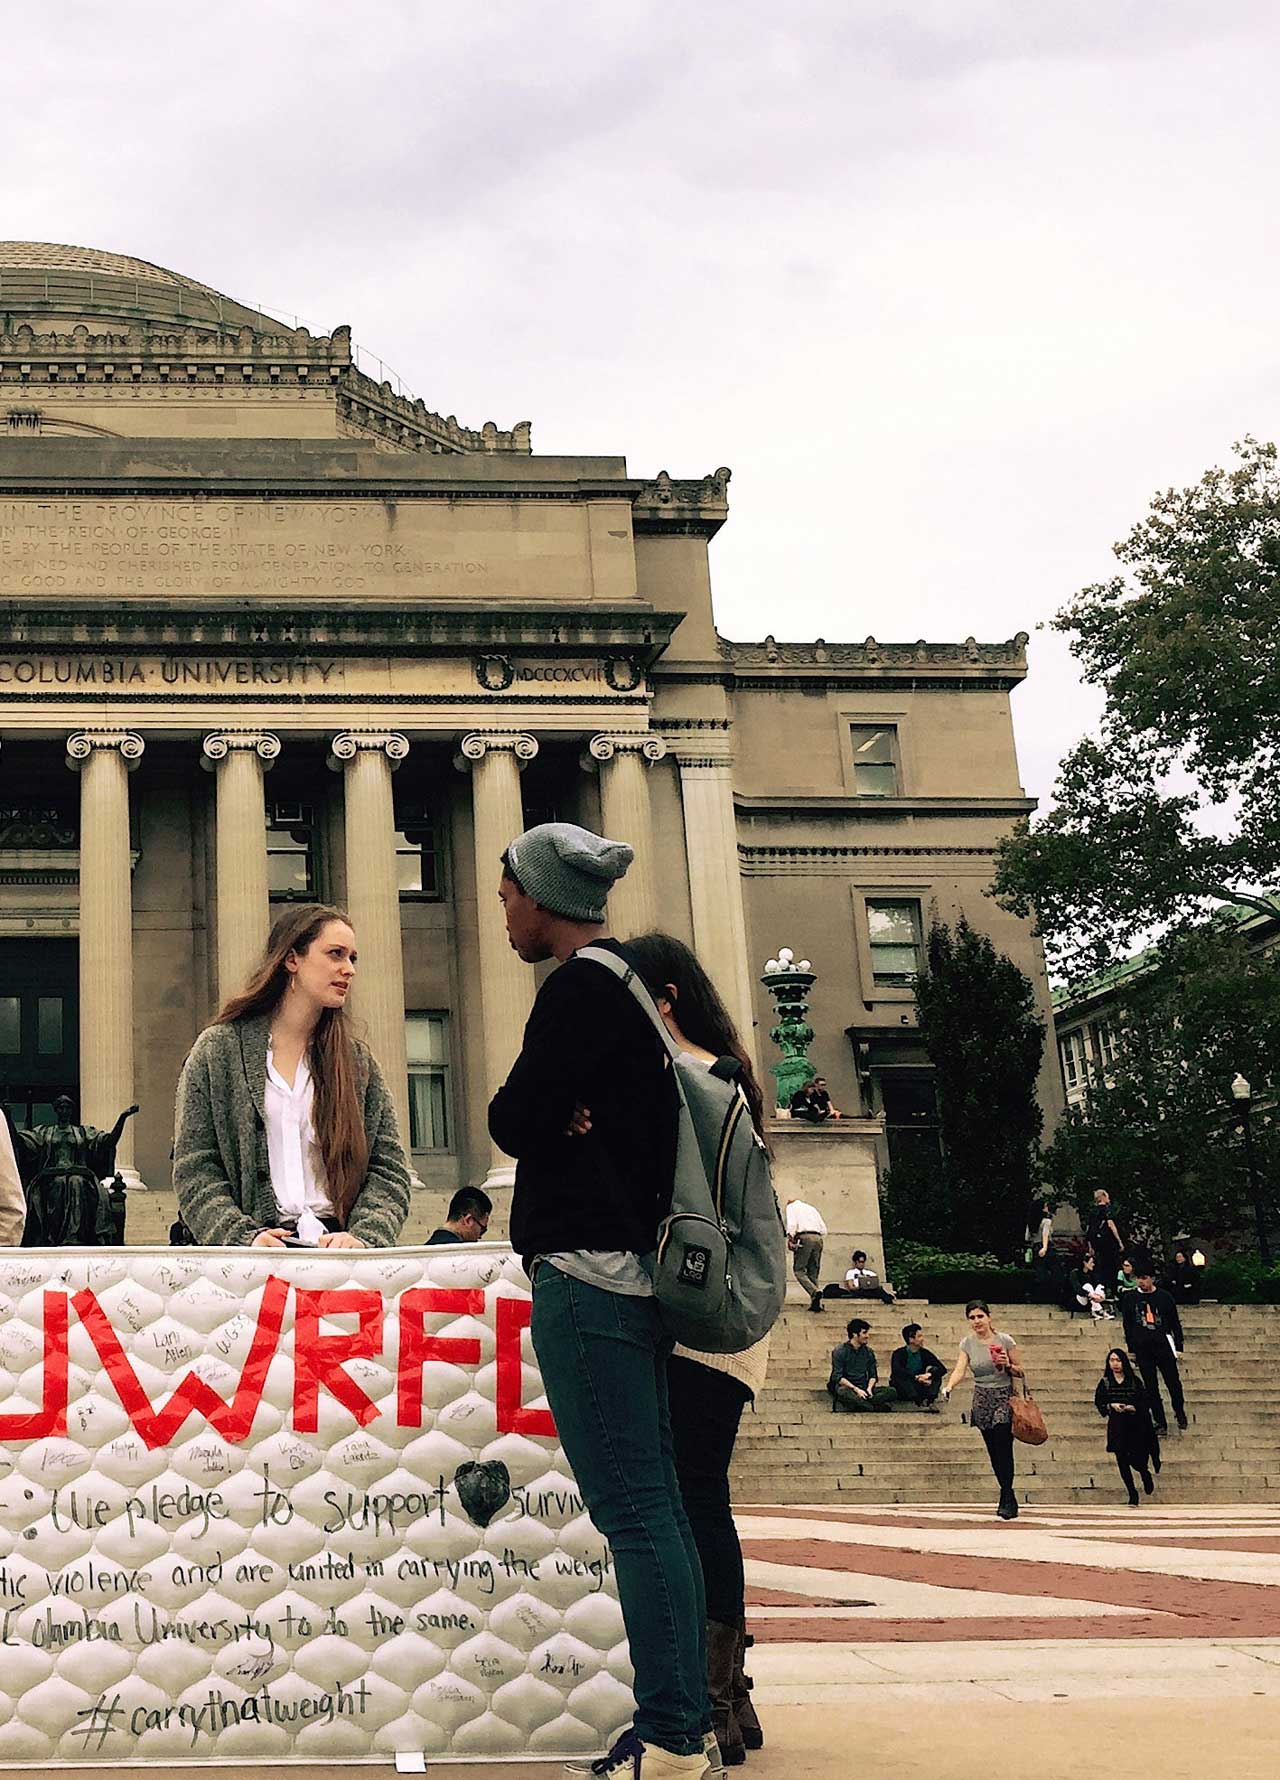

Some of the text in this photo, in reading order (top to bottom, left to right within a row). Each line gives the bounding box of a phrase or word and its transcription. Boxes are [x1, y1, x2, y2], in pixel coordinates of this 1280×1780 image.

[3, 504, 26, 521] IN
[37, 504, 82, 521] THE
[96, 505, 205, 522] PROVINCE
[215, 505, 245, 522] OF
[0, 525, 16, 537] IN
[24, 526, 59, 538] THE
[69, 526, 116, 538] REIGN
[126, 526, 148, 538] OF
[157, 527, 221, 539] GEORGE
[21, 542, 40, 555] BY
[48, 542, 83, 555] THE
[92, 543, 149, 556] PEOPLE
[158, 543, 180, 556] OF
[188, 543, 220, 556] THE
[230, 544, 275, 557] STATE
[285, 544, 307, 557] OF
[314, 544, 352, 557] NEW
[360, 545, 407, 558] YORK
[365, 561, 384, 573] TO
[393, 562, 489, 574] GENERATION
[21, 575, 66, 587] GOOD
[116, 576, 145, 588] THE
[212, 576, 232, 588] OF
[332, 577, 366, 589] GOD
[160, 661, 336, 684] UNIVERSITY
[51, 1489, 111, 1534] We
[125, 1484, 231, 1541] pledge
[253, 1462, 294, 1528] to
[323, 1474, 450, 1538] support
[45, 1560, 152, 1597] violence
[171, 1551, 223, 1587] and
[235, 1562, 276, 1584] are
[288, 1552, 355, 1583] united
[365, 1555, 384, 1578] in
[397, 1553, 496, 1595] carrying
[498, 1548, 540, 1582] the
[2, 1602, 123, 1650] Columbia
[134, 1601, 275, 1659] University
[278, 1604, 313, 1639] to
[322, 1605, 350, 1638] do
[365, 1604, 404, 1637] the
[416, 1612, 476, 1636] same.
[71, 1678, 373, 1752] #carrythatweight
